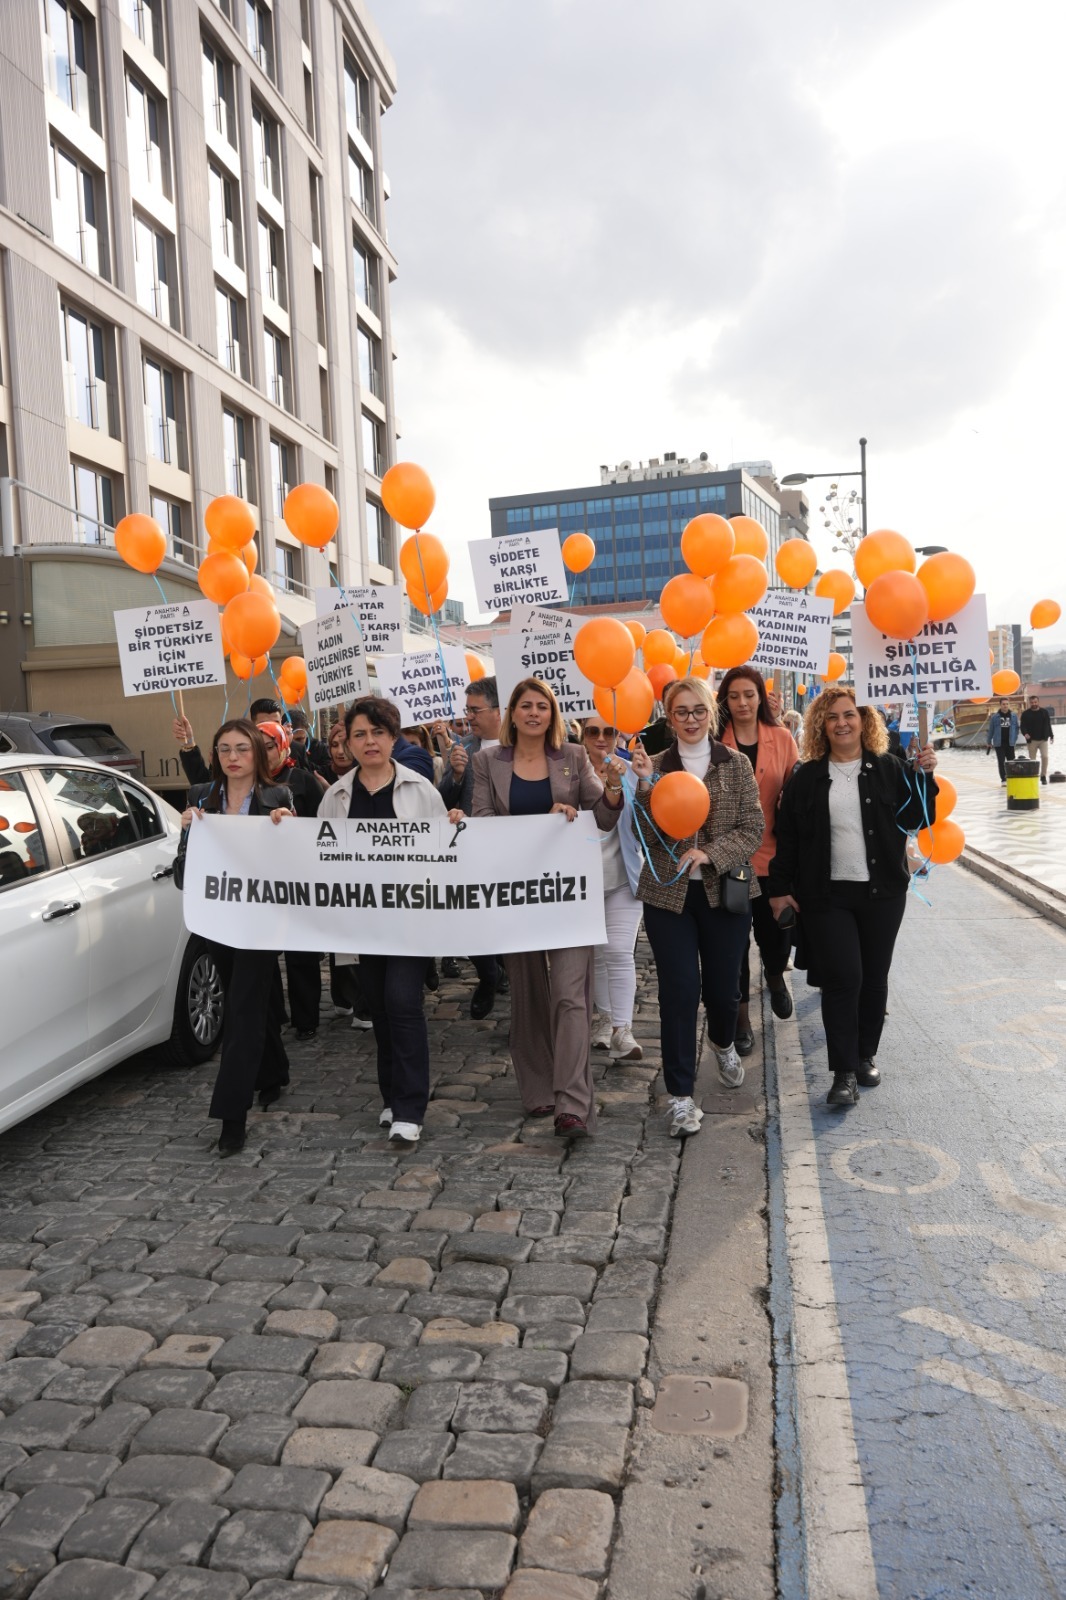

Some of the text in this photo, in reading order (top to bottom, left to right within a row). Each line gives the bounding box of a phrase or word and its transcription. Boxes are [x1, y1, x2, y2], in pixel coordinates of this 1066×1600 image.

[489, 547, 540, 567] ŞİDDETE
[500, 563, 537, 577] KARŞI
[493, 576, 549, 594] BİRLİKTE
[485, 589, 562, 610] YÜRÜYORUZ.
[744, 606, 831, 625] NAHTAR PARTİ
[134, 620, 204, 639] ŞİDDETSİZ
[368, 622, 400, 632] KARŞI
[757, 619, 807, 634] KADININ
[128, 632, 213, 652] BİR TÜRKİYE
[317, 633, 343, 651] KADIN
[371, 632, 390, 642] BİR
[758, 631, 808, 646] YANINDA
[158, 649, 186, 663] İÇİN
[308, 644, 361, 672] GÜÇLENİRSE
[756, 641, 809, 657] ŞİDDETİN
[885, 641, 956, 662] ŞİDDET
[143, 661, 204, 677] BİRLİKTE
[748, 654, 818, 671] ARŞISINDA!
[868, 657, 977, 679] İNSANLIĞA
[316, 664, 353, 686] TÜRKİYE
[401, 665, 445, 680] KADIN
[532, 667, 567, 681] GÜÇ
[132, 673, 218, 692] YÜRÜYORUZ.
[389, 676, 465, 697] YAŞAMDIR;
[867, 676, 980, 698] İHANETTİR.
[314, 681, 356, 703] GÜÇLENİR
[404, 691, 456, 708] YAŞAMI
[412, 706, 456, 722] KORU.
[316, 820, 337, 840] A
[355, 822, 431, 833] ANAHTAR
[319, 851, 458, 863] İZMİR İL KADIN KOLLARI
[204, 870, 243, 902] BİR
[246, 878, 311, 906] KADIN
[314, 882, 378, 908] DAHA
